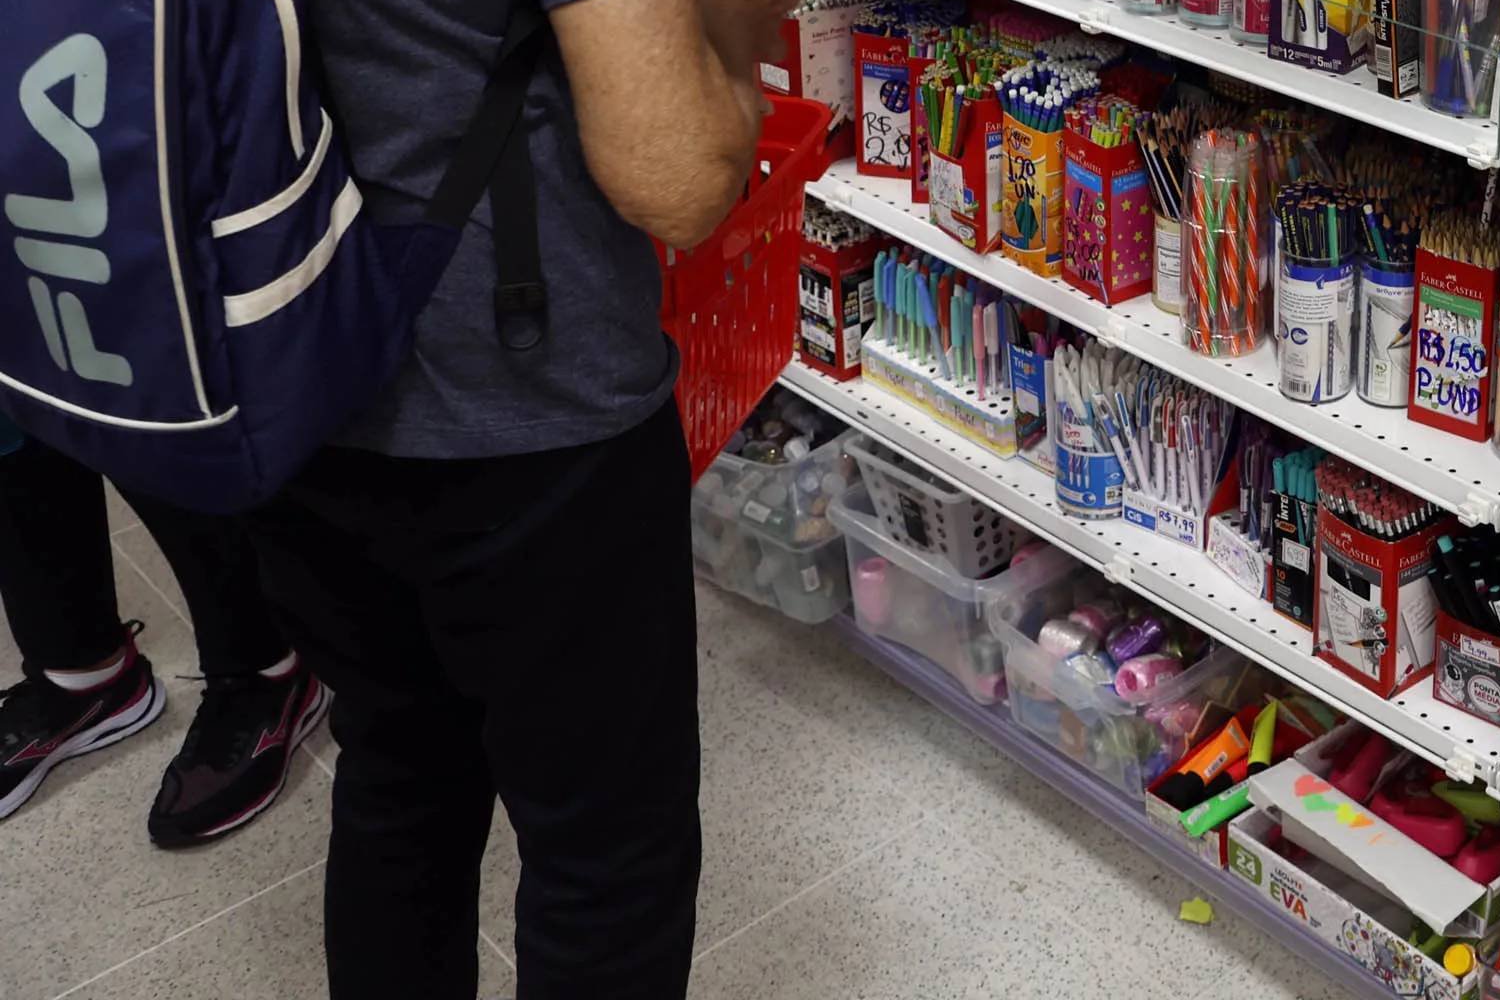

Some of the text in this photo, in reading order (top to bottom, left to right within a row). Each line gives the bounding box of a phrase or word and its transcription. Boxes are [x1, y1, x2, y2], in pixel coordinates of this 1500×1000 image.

[1283, 48, 1295, 59] 12
[863, 112, 892, 136] R$
[4, 32, 134, 387] FILA
[1419, 327, 1446, 367] R$
[1127, 510, 1143, 522] CiS
[1158, 510, 1172, 523] R$
[1473, 681, 1500, 697] PONTA
[1473, 689, 1500, 707] MÉDIA
[1236, 853, 1257, 876] 24
[1270, 881, 1308, 921] EVA
